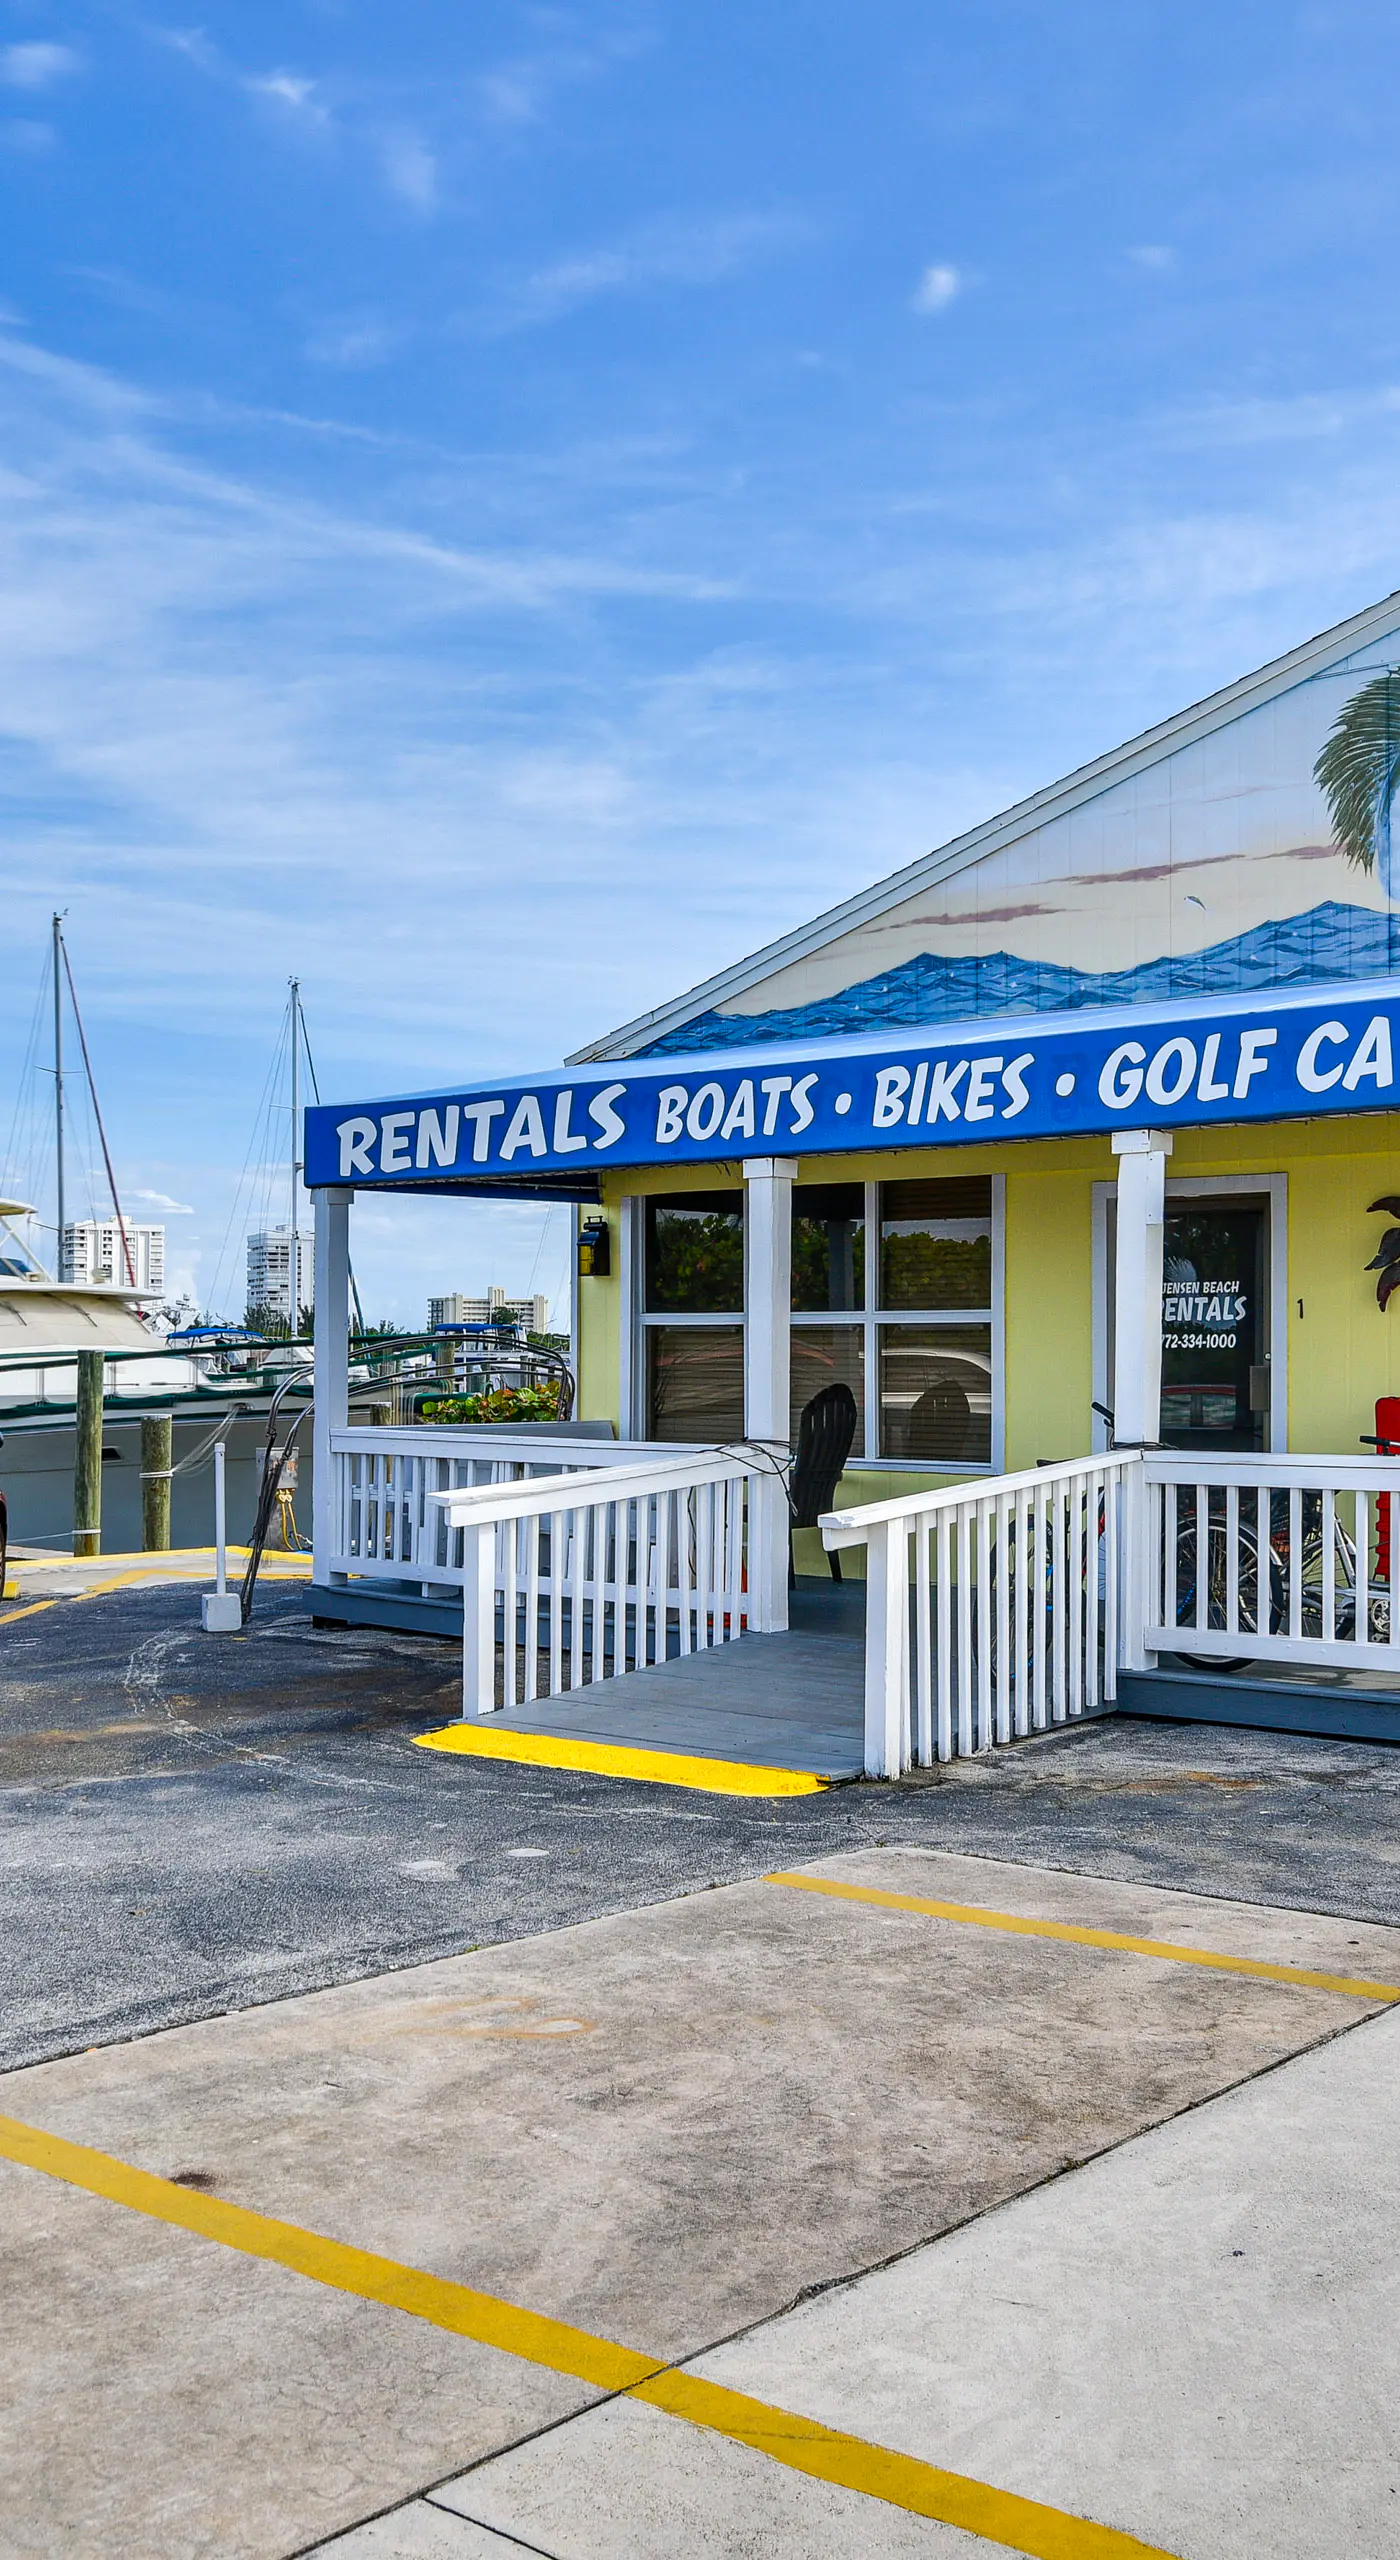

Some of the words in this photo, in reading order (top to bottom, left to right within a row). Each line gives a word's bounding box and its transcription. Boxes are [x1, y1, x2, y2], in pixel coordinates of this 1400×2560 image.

[336, 1083, 627, 1177] RENTALS
[655, 1072, 819, 1144] BOATS
[871, 1052, 1035, 1128] BIKES
[1098, 1027, 1278, 1109] GOLF
[1296, 1016, 1394, 1093] CA
[1203, 1280, 1240, 1293] BEACH
[1161, 1295, 1247, 1322] ENTALS
[1297, 1298, 1304, 1319] 1
